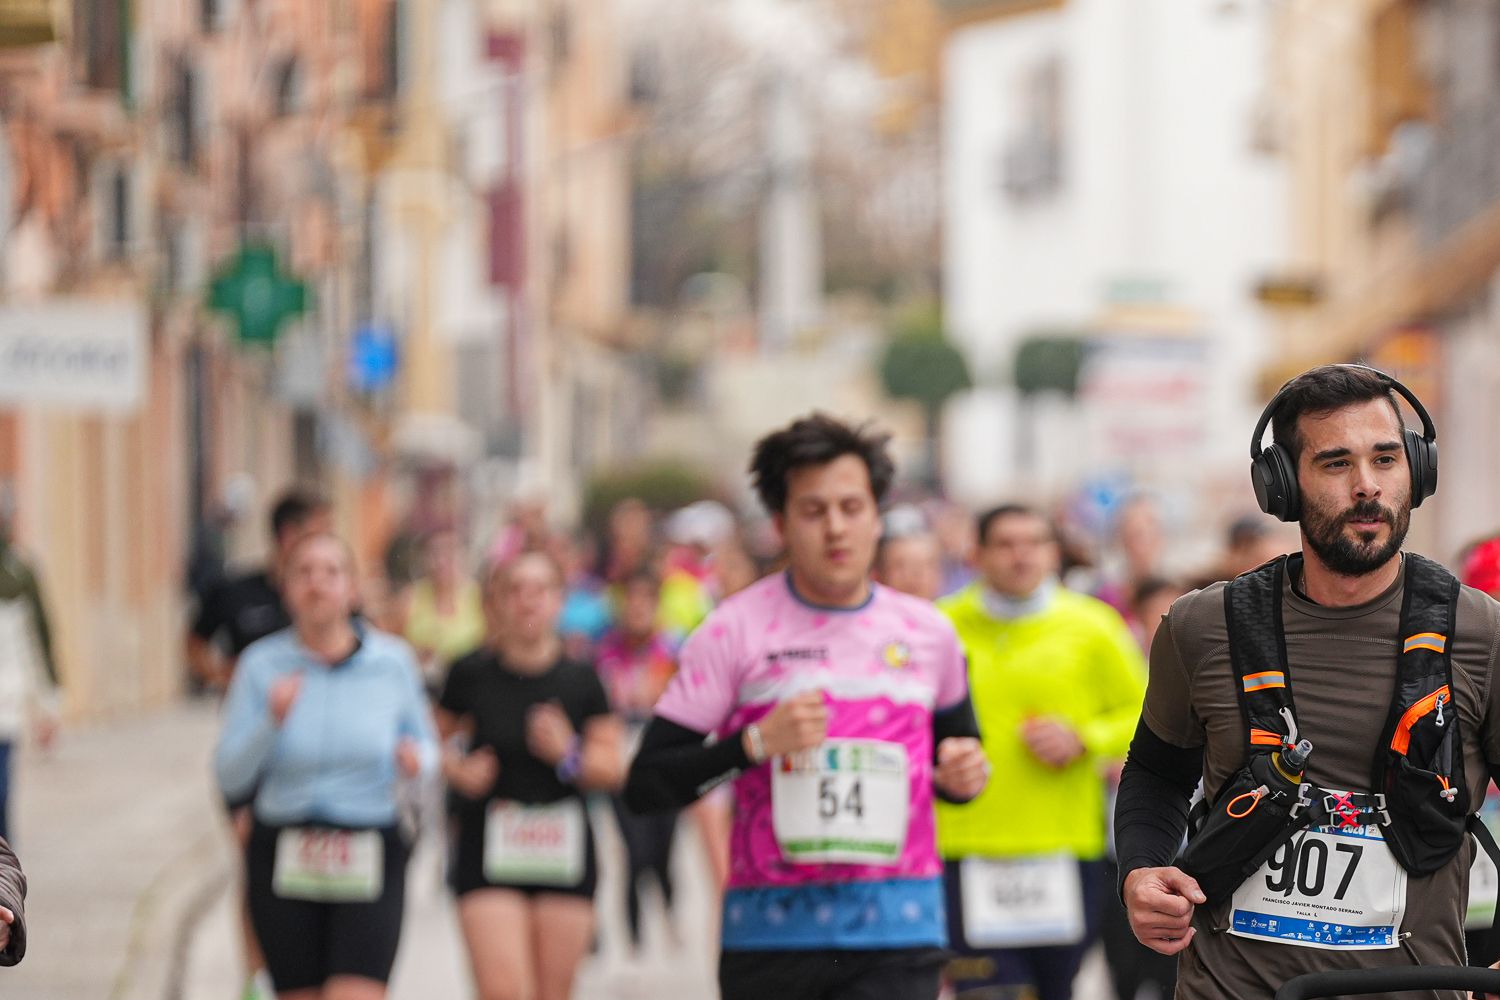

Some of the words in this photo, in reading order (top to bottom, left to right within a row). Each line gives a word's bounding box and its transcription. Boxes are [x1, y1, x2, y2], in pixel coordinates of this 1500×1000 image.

[819, 778, 864, 820] 54
[1265, 837, 1364, 900] 907
[1262, 896, 1291, 905] FRANCISCO
[1311, 904, 1338, 912] MONTADO
[1338, 907, 1363, 915] SERRANO
